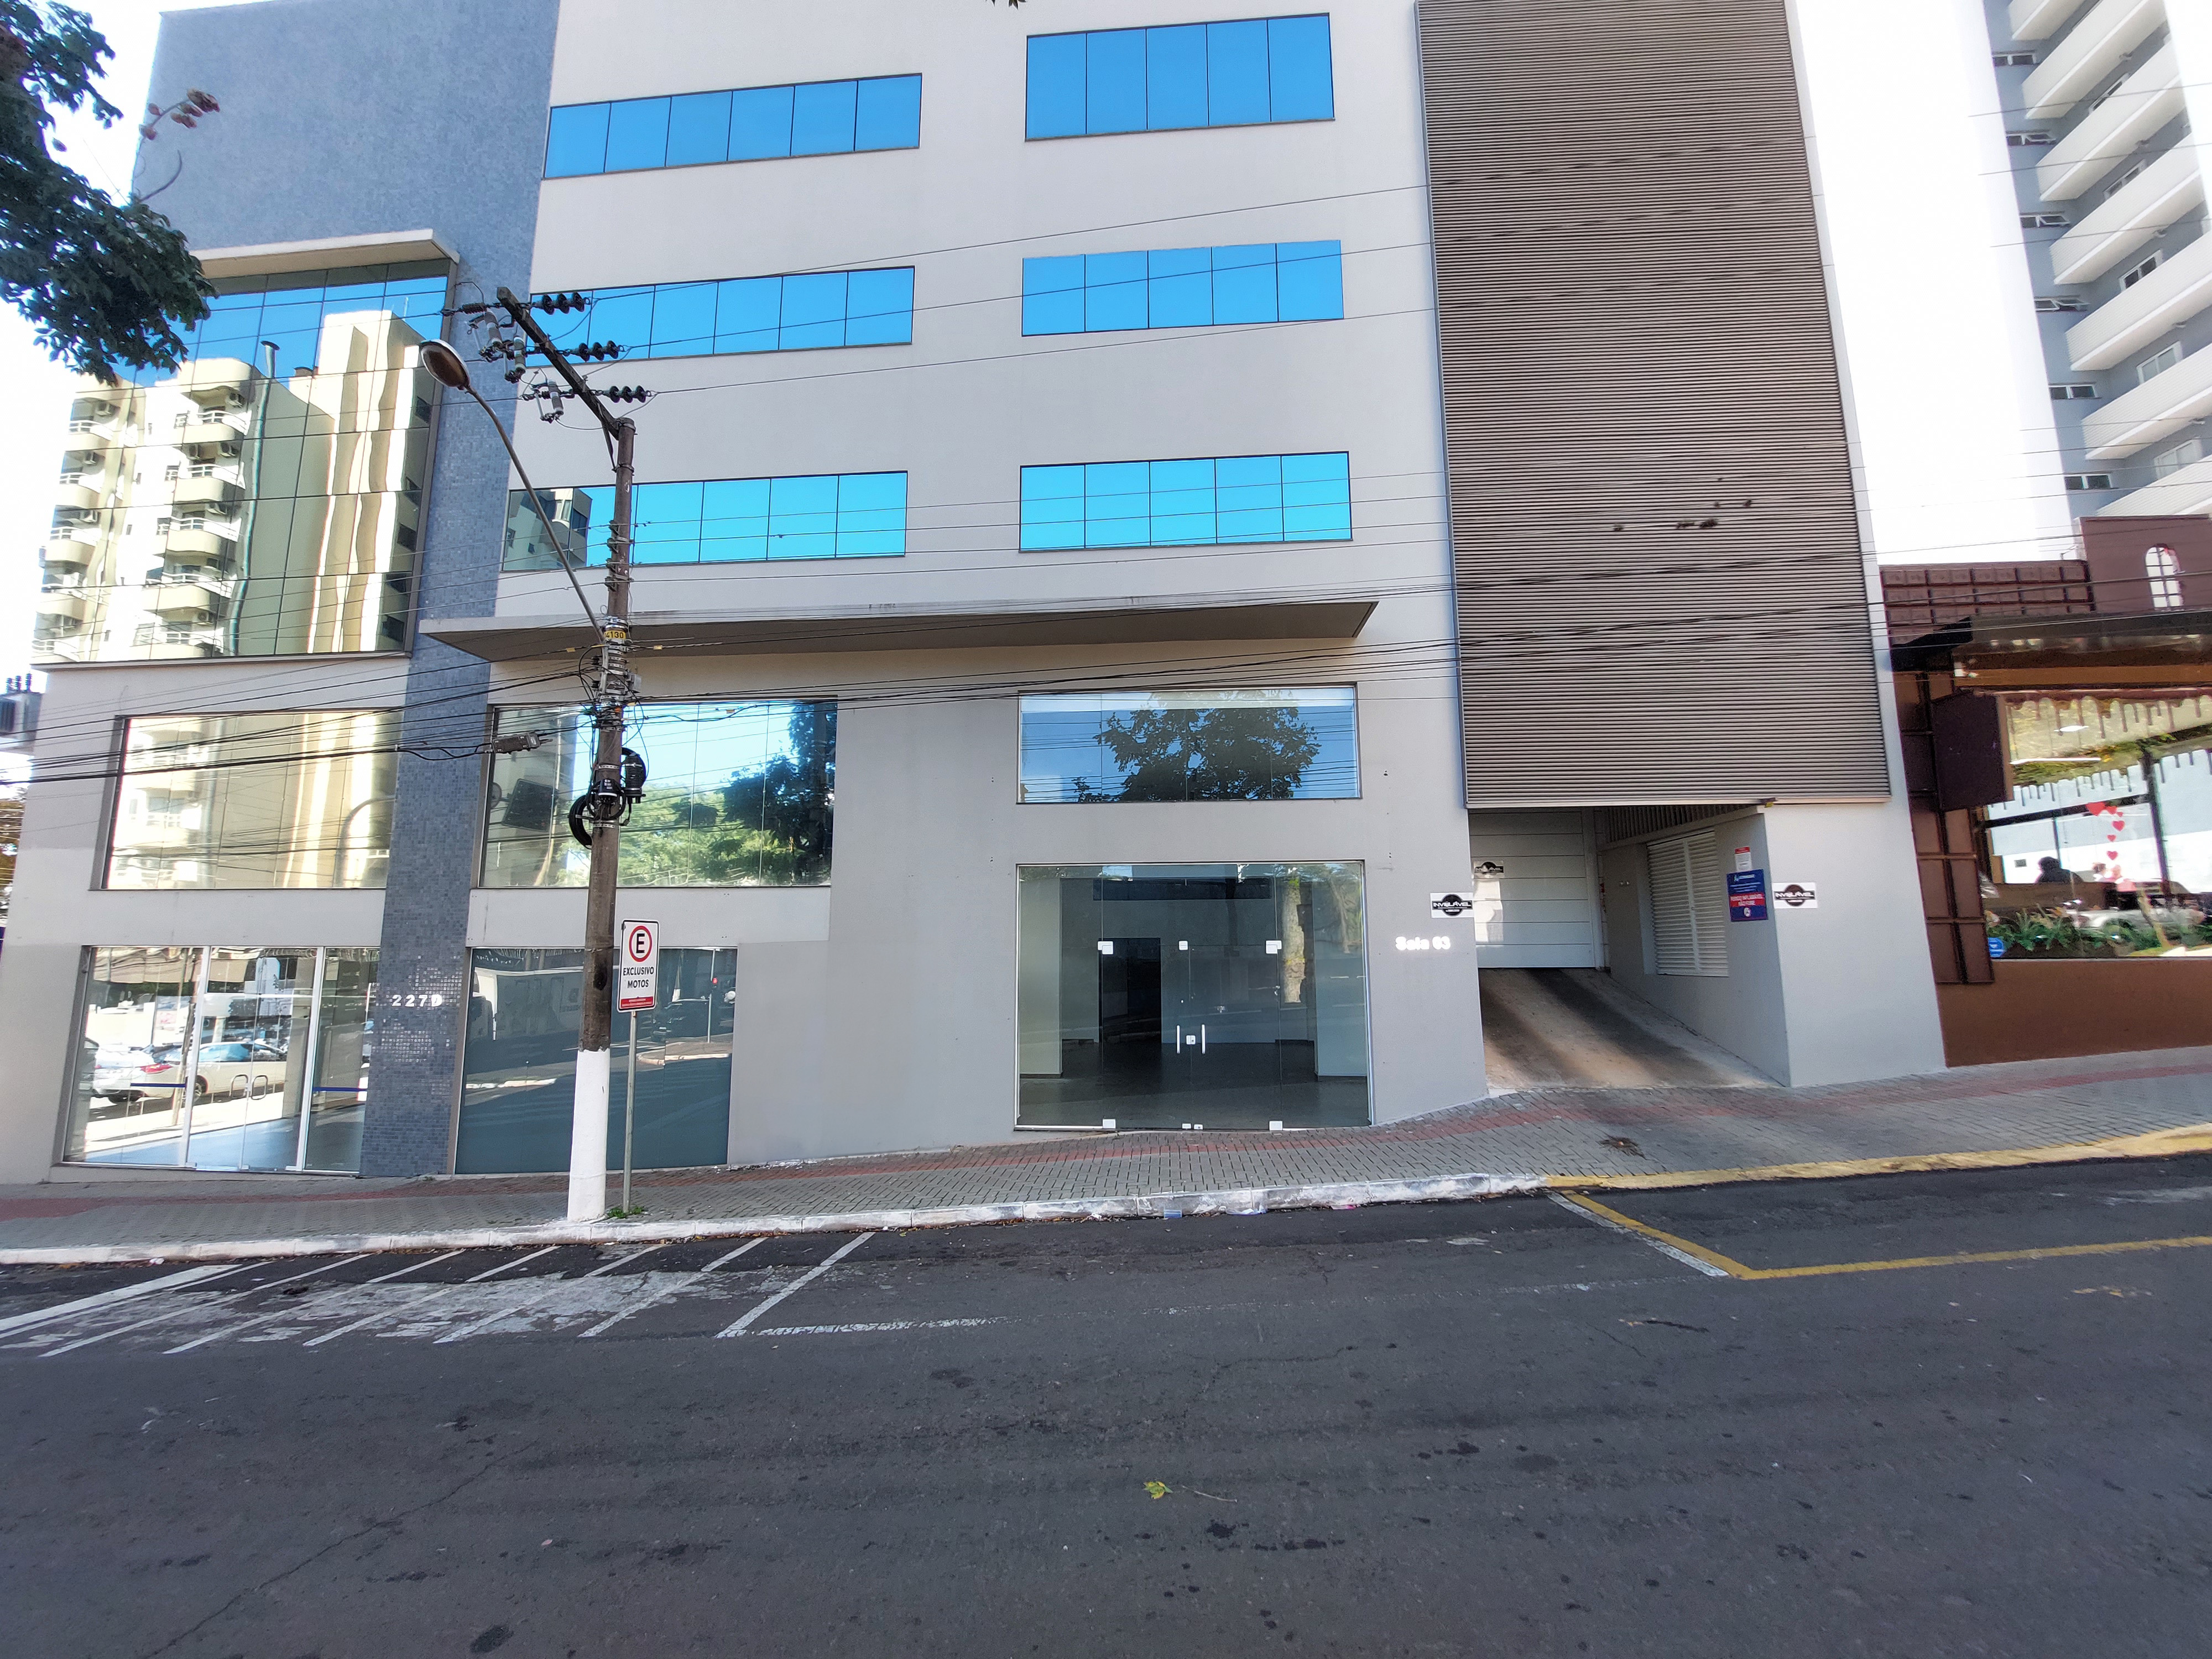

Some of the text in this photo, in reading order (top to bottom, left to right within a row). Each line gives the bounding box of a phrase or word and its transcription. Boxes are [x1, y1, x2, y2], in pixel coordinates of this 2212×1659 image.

[636, 933, 645, 953] E
[1395, 936, 1430, 951] Sala
[623, 967, 654, 976] EXCLUSIVO
[627, 979, 649, 989] MOTOS
